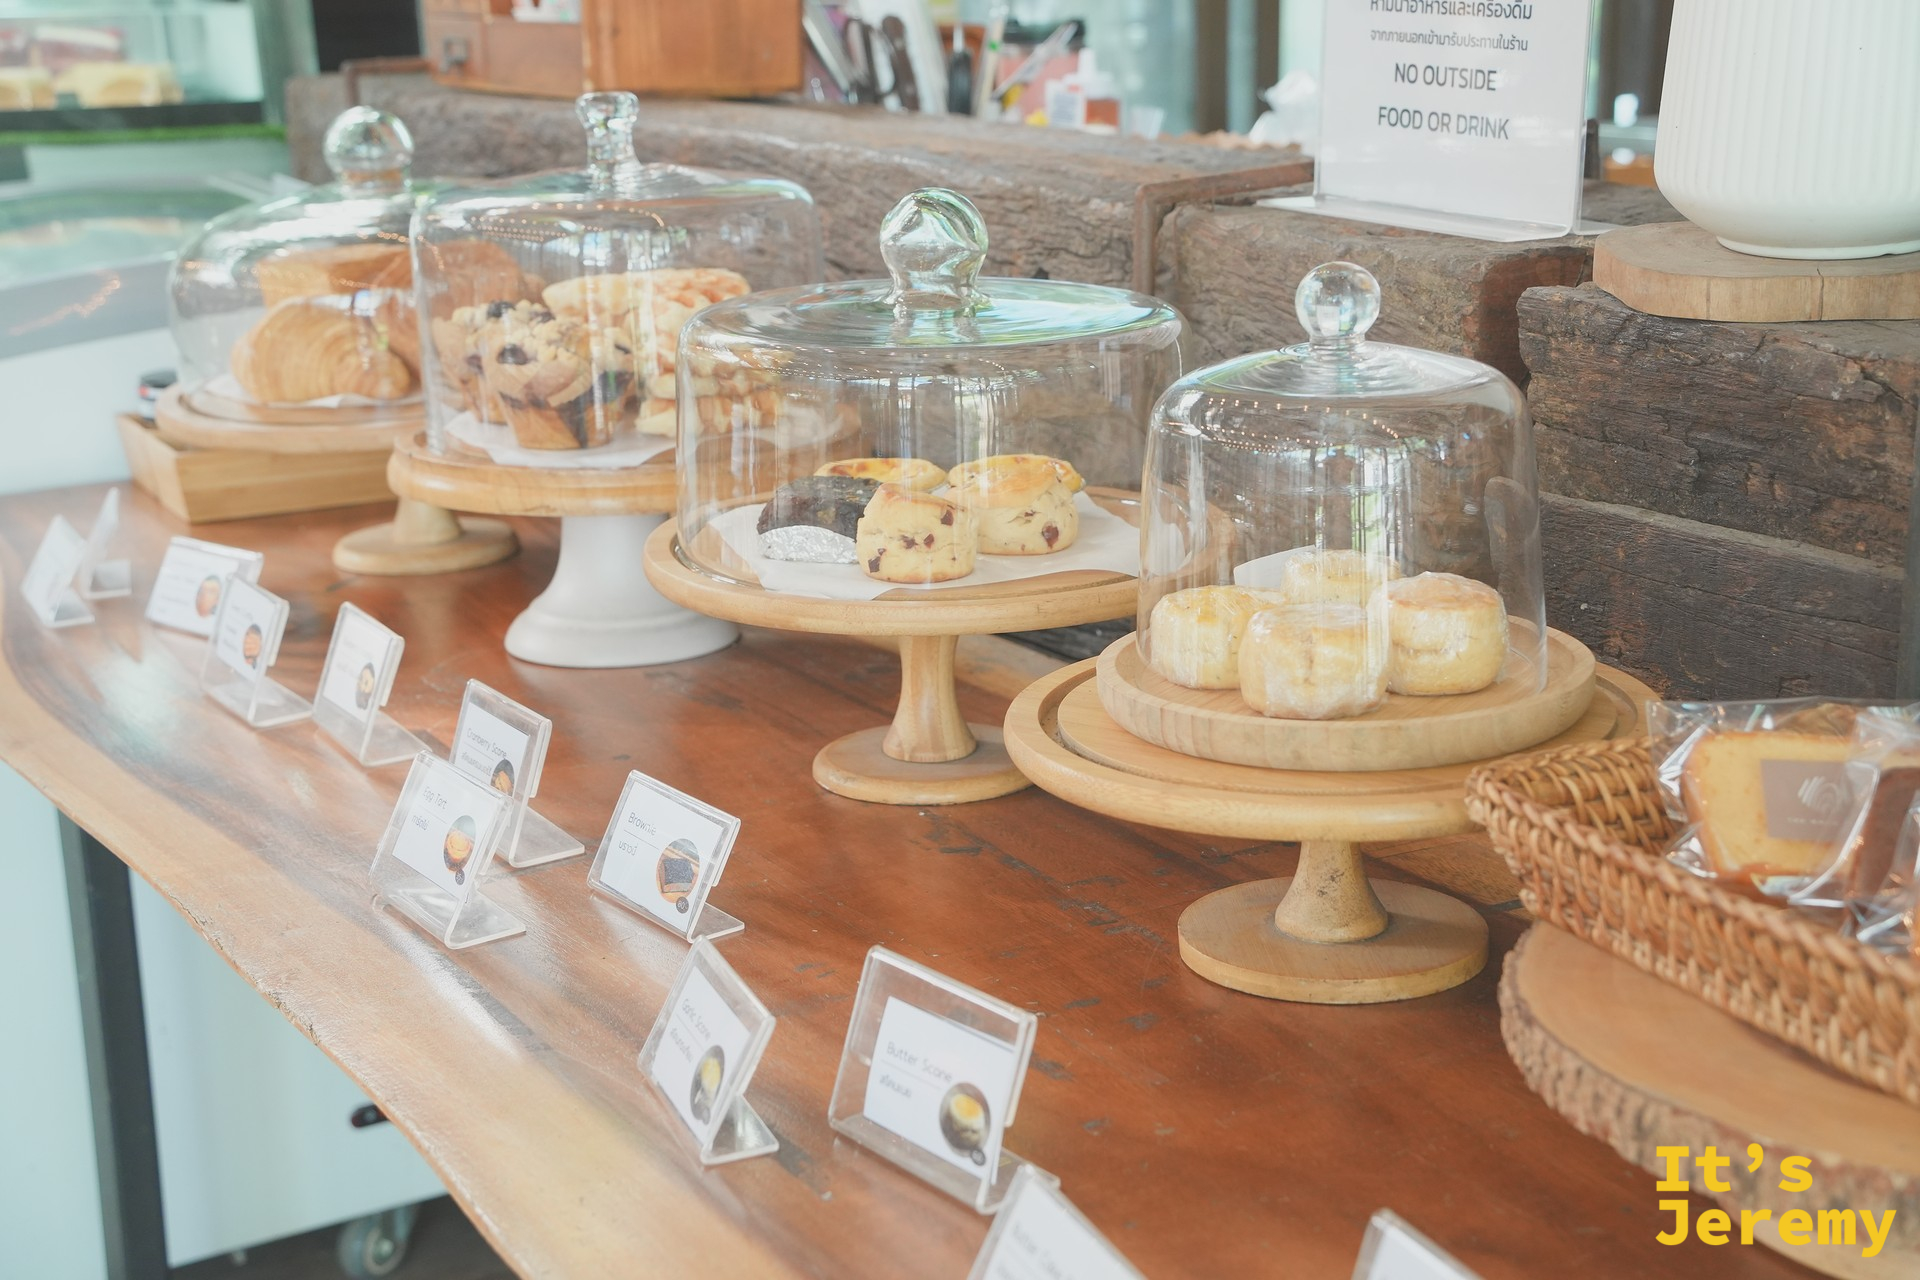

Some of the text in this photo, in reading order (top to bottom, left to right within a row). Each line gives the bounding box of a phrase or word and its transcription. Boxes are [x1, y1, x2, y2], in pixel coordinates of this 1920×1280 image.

[1394, 62, 1497, 91] NO OUTSIDE
[1378, 106, 1509, 140] FOOD OR DRINK
[628, 811, 656, 836] Brownie
[887, 1041, 953, 1083] Butter Scone
